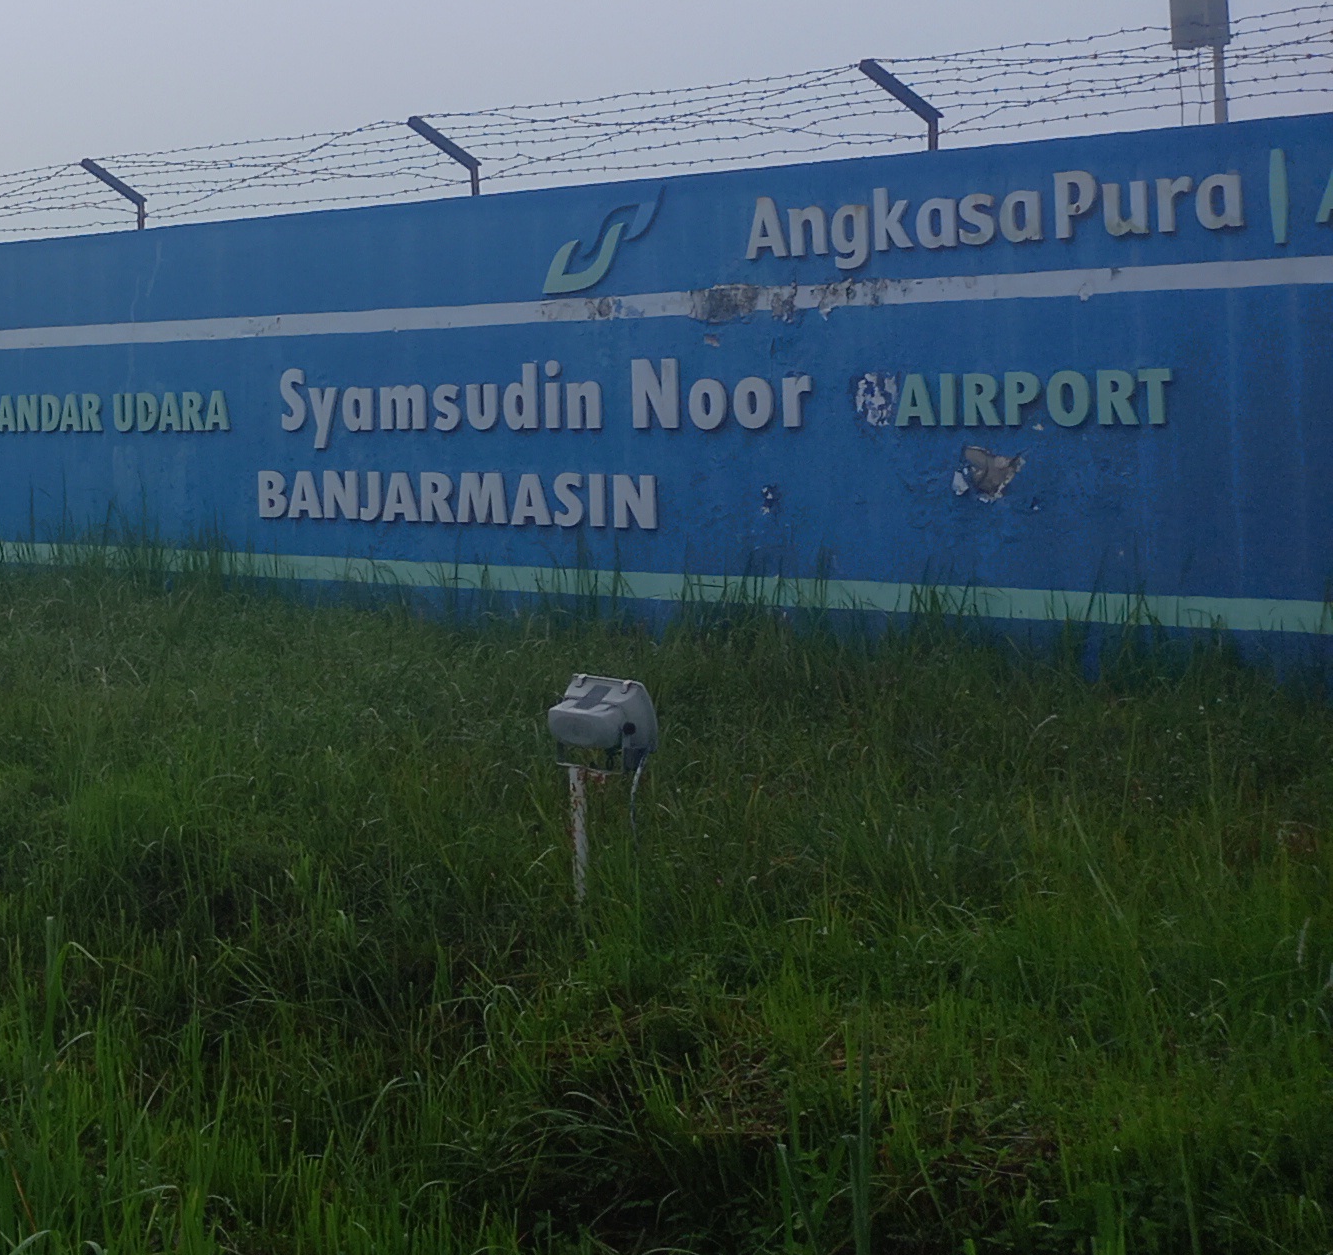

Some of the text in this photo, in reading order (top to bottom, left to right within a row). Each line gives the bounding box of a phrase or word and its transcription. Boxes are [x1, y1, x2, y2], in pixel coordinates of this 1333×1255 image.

[112, 390, 231, 432] UDARA
[279, 359, 603, 449] Syamsudin
[630, 358, 812, 431] Noor
[894, 367, 1174, 427] AIRPORT
[257, 470, 659, 530] BANJARMASIN
